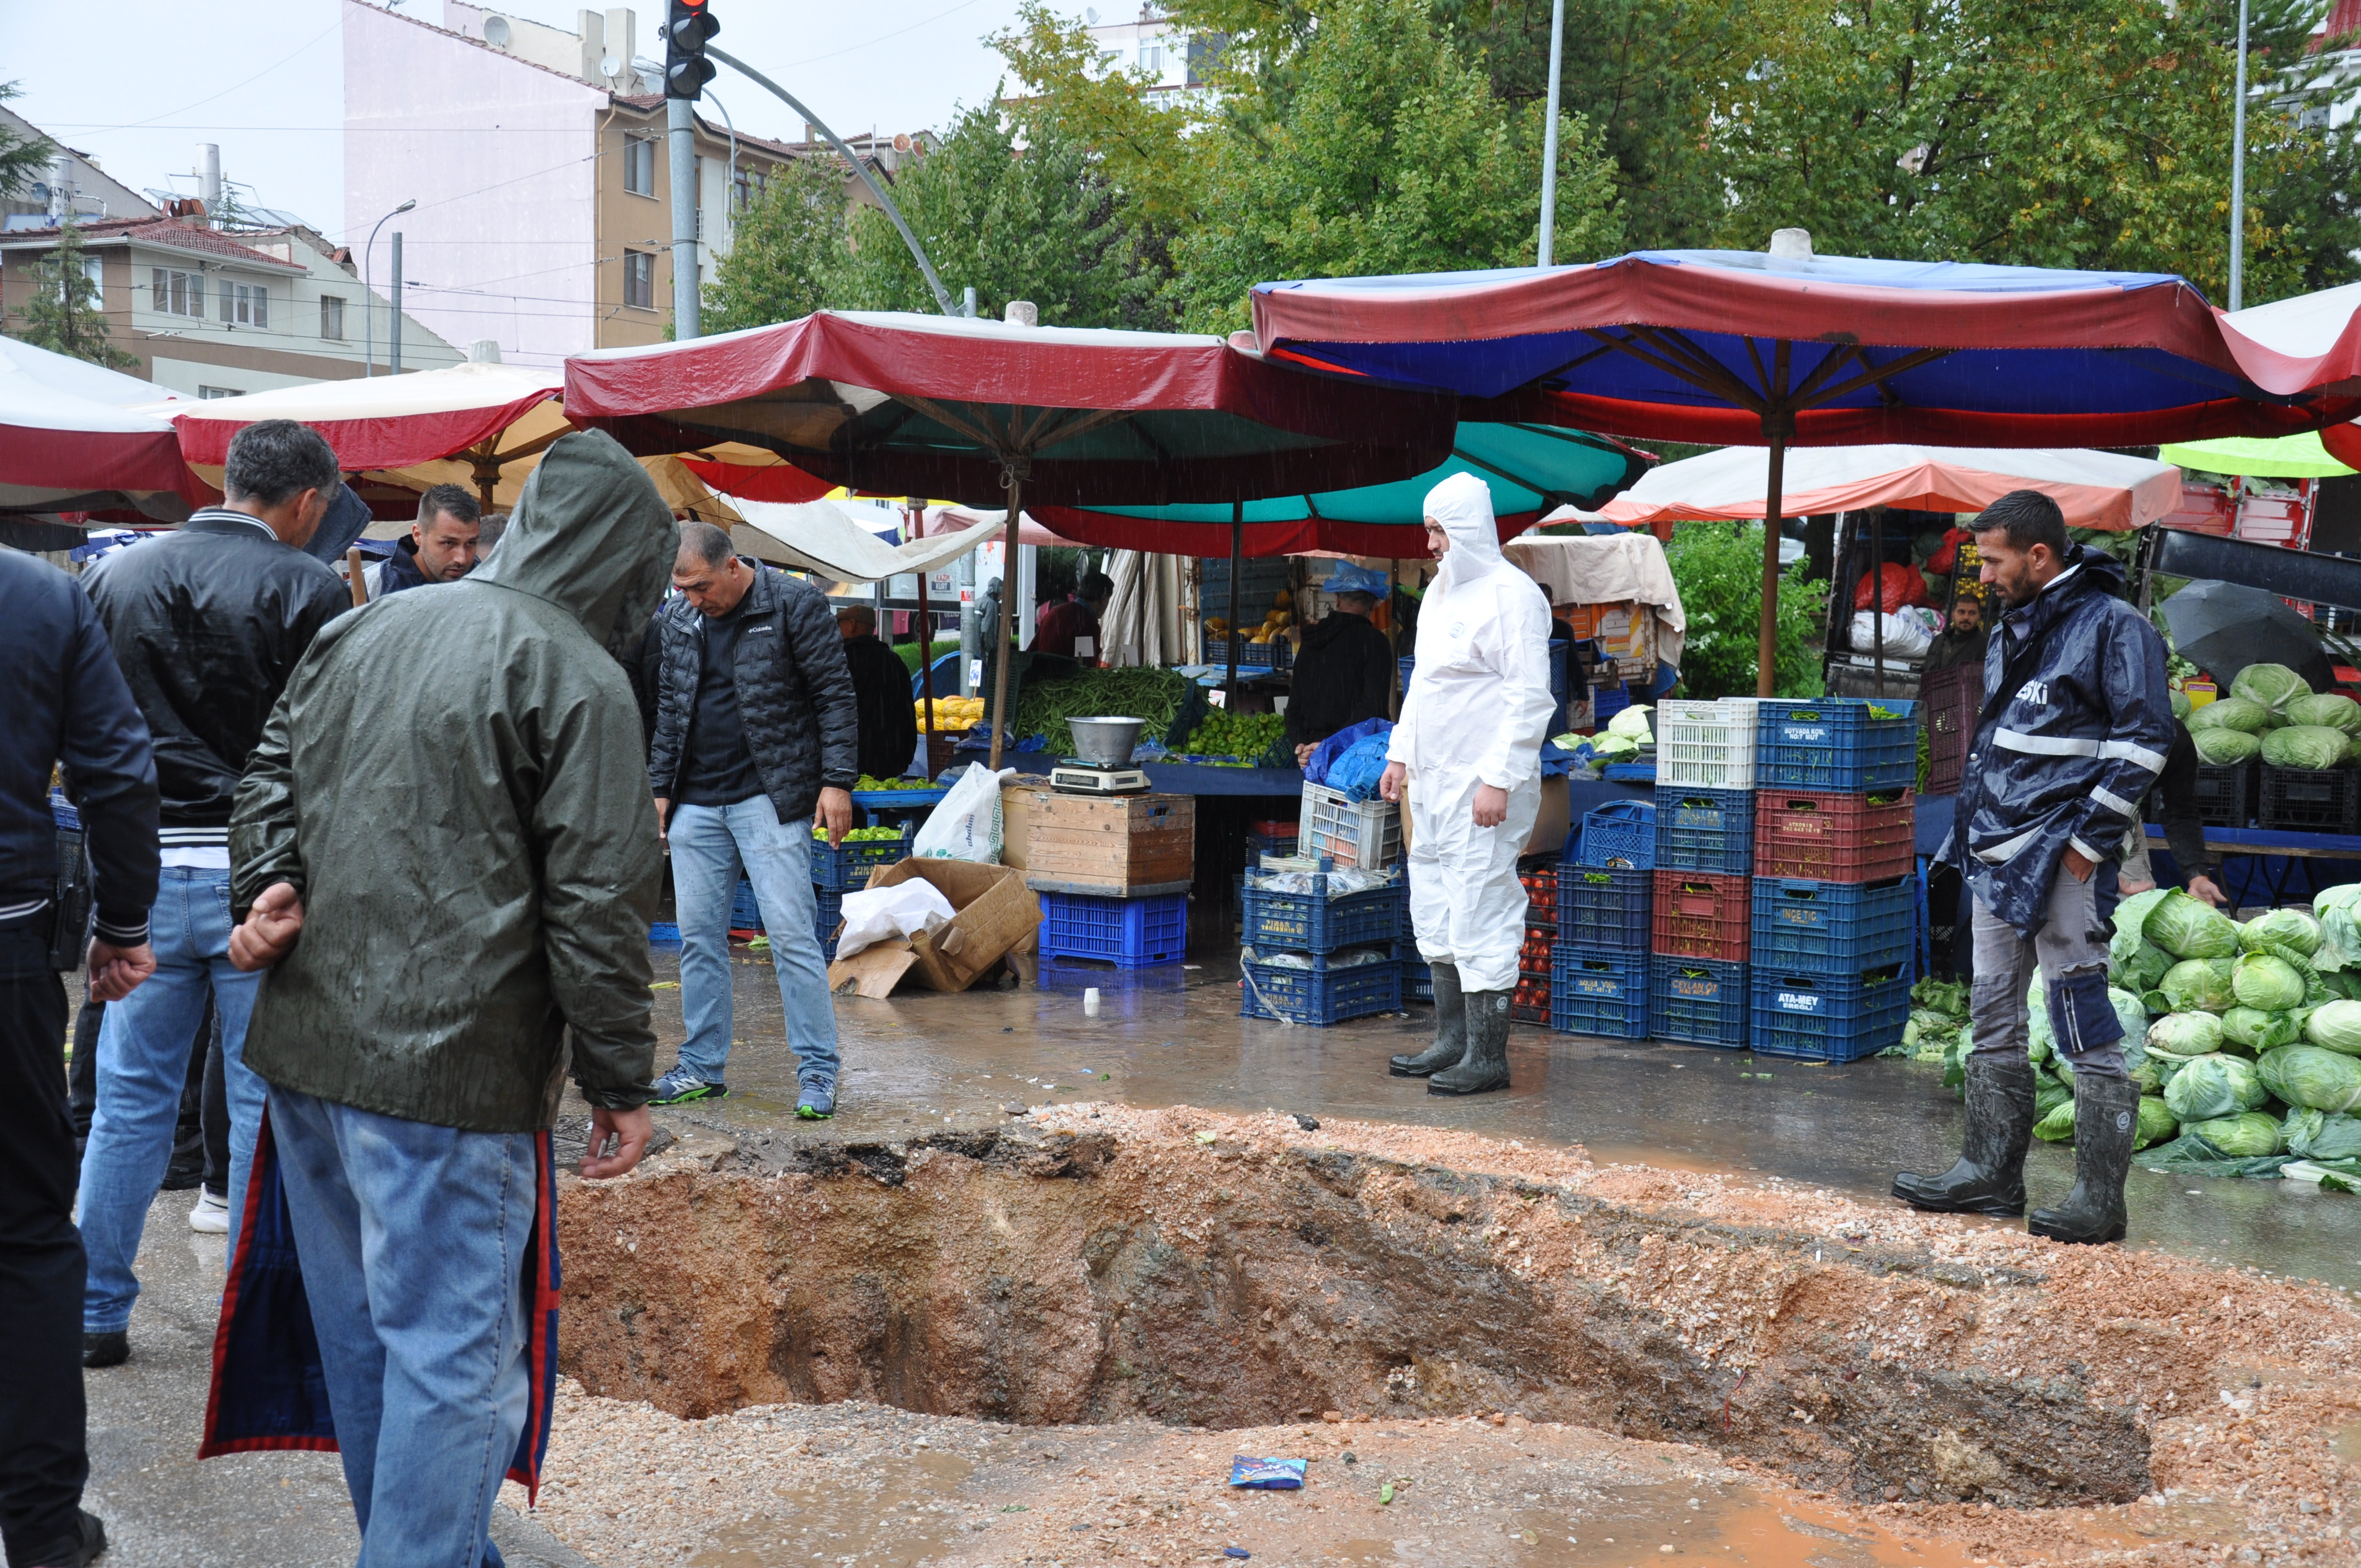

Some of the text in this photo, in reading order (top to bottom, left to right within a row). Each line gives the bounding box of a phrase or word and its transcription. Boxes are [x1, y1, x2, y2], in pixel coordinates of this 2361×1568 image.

[1266, 919, 1304, 934] PINAR 9
[1778, 993, 1819, 1006] ATA-MEY
